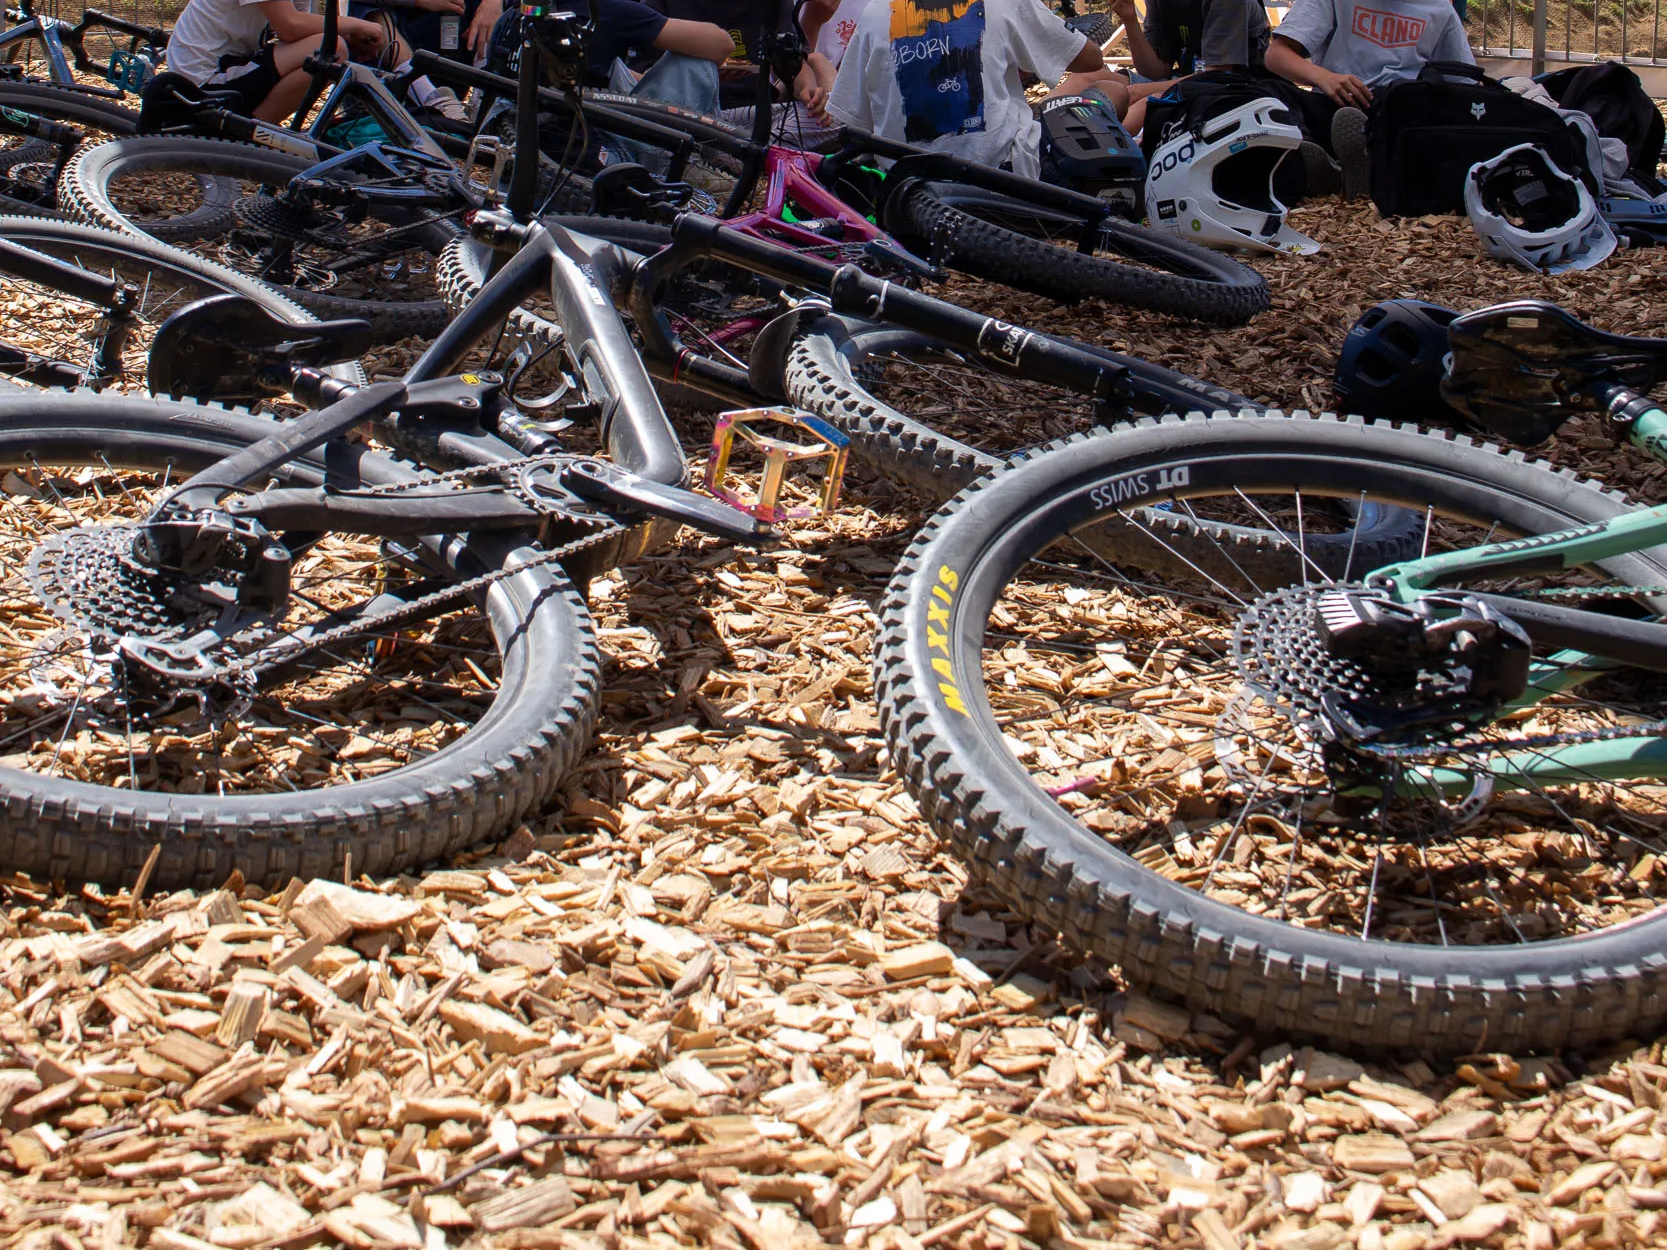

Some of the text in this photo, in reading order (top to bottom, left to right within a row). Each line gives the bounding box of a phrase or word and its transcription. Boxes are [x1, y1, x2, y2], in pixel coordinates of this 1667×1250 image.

[1090, 466, 1190, 510] DT SWISS
[926, 564, 971, 718] MAXXIS
